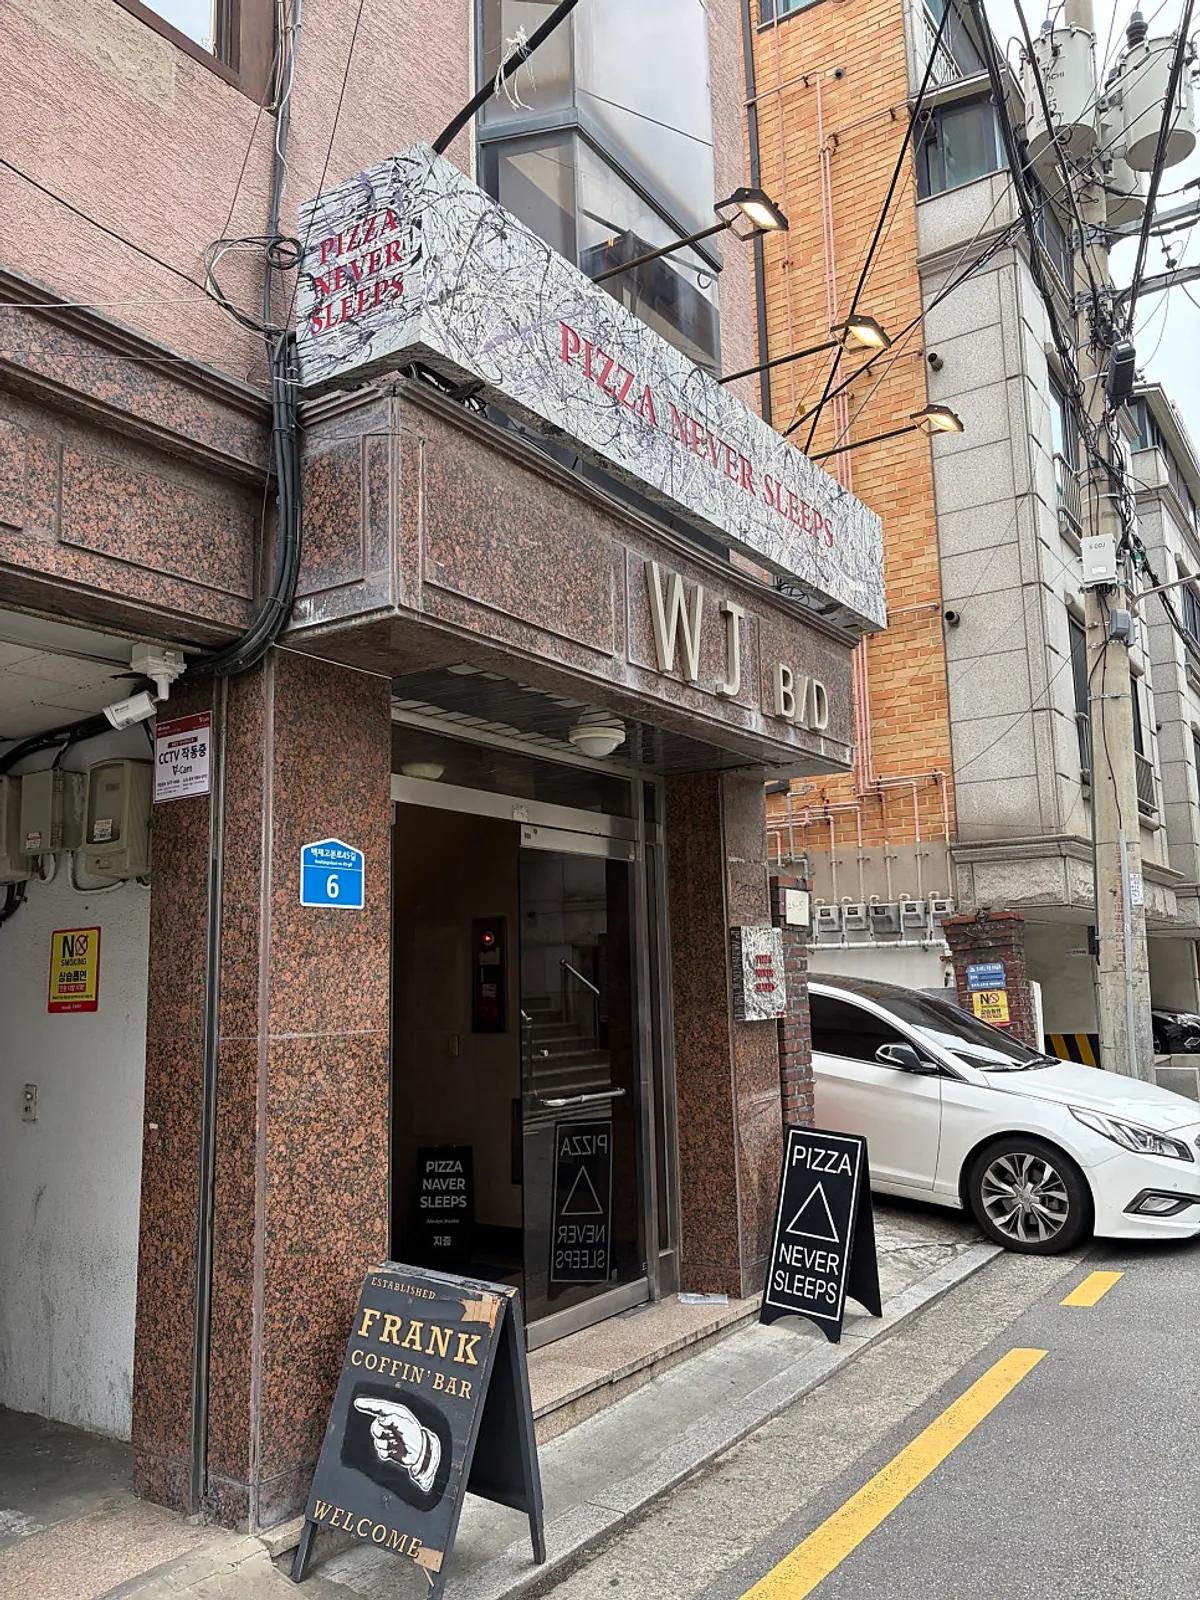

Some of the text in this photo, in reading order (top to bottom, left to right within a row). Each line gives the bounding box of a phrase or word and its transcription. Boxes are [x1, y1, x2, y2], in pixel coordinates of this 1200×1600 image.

[320, 208, 398, 266] PIZZA
[315, 240, 404, 301] NEVER
[310, 272, 404, 335] SLEEPS
[559, 321, 834, 548] PIZZA NEVER SLEEPS
[774, 663, 829, 730] B/D
[159, 749, 180, 765] CCTV
[326, 874, 340, 899] 6
[426, 1160, 464, 1173] PIZZA
[792, 1145, 852, 1177] PIZZA
[422, 1178, 466, 1191] NAVER
[420, 1195, 467, 1208] SLEEPS
[779, 1243, 839, 1276] NEVER
[371, 1277, 436, 1300] ESTABLISHED
[773, 1270, 838, 1304] SLEEPS
[357, 1308, 482, 1366] FRANK
[432, 1372, 472, 1400] BAR
[313, 1500, 423, 1558] WELCOME
